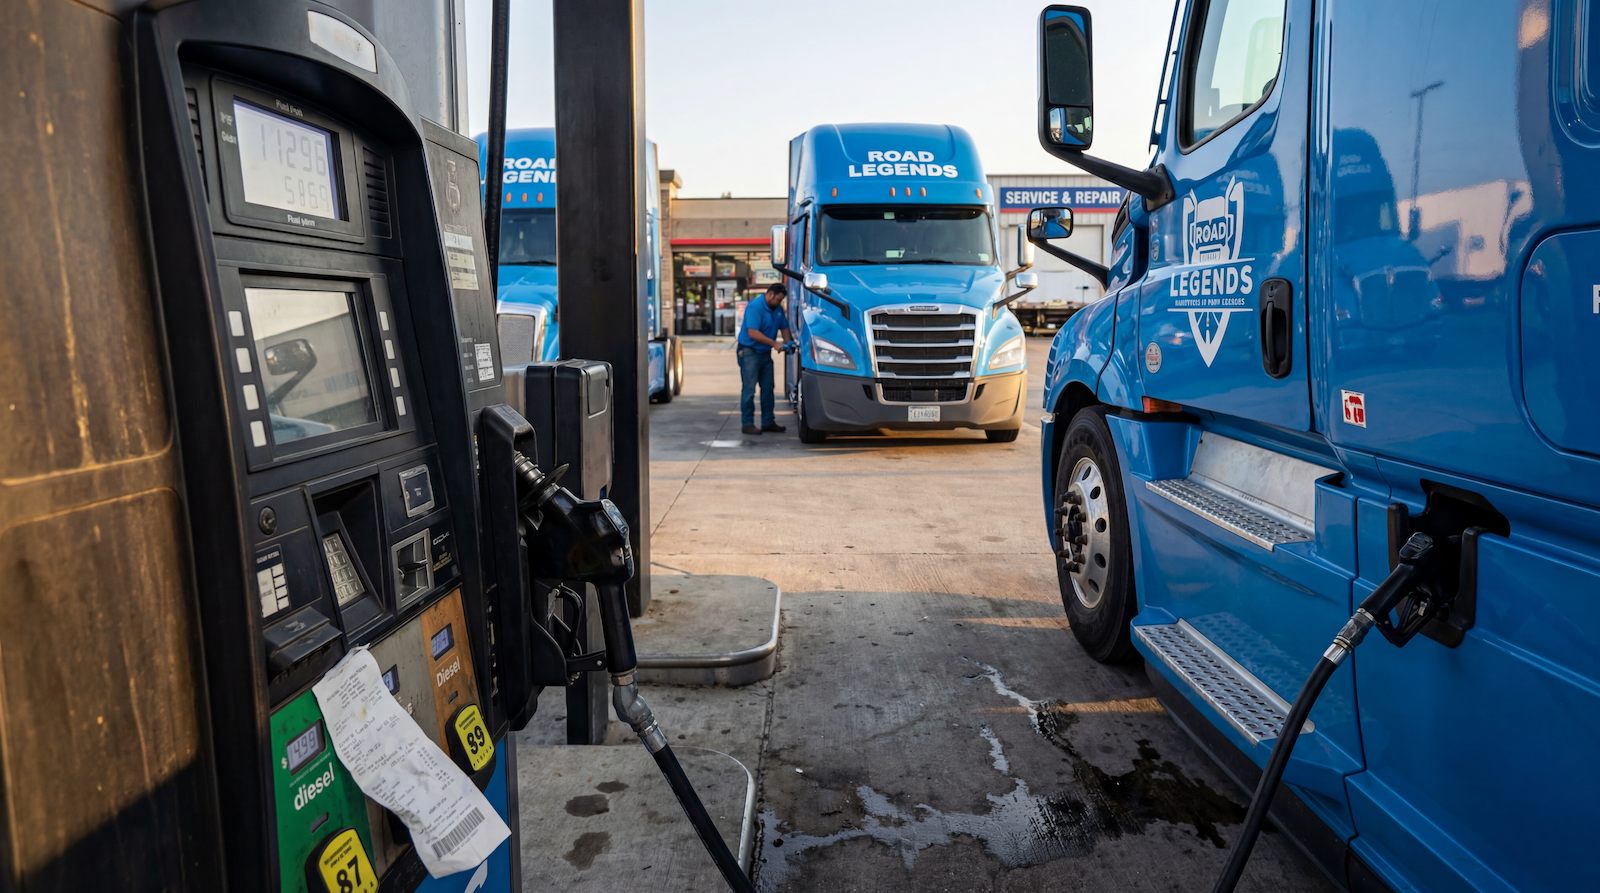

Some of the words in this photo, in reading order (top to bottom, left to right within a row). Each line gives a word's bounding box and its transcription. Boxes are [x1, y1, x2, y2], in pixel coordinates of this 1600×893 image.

[848, 163, 958, 178] LEGENDS
[868, 150, 934, 162] ROAD
[1005, 191, 1059, 204] SERVICE
[1062, 191, 1071, 204] &
[1075, 191, 1120, 204] REPAIR
[1196, 222, 1226, 243] ROAD
[1169, 265, 1253, 297] LEGENDS
[437, 655, 460, 687] Diesel
[467, 725, 485, 754] 89
[294, 762, 335, 810] diesel
[336, 854, 361, 893] 87
